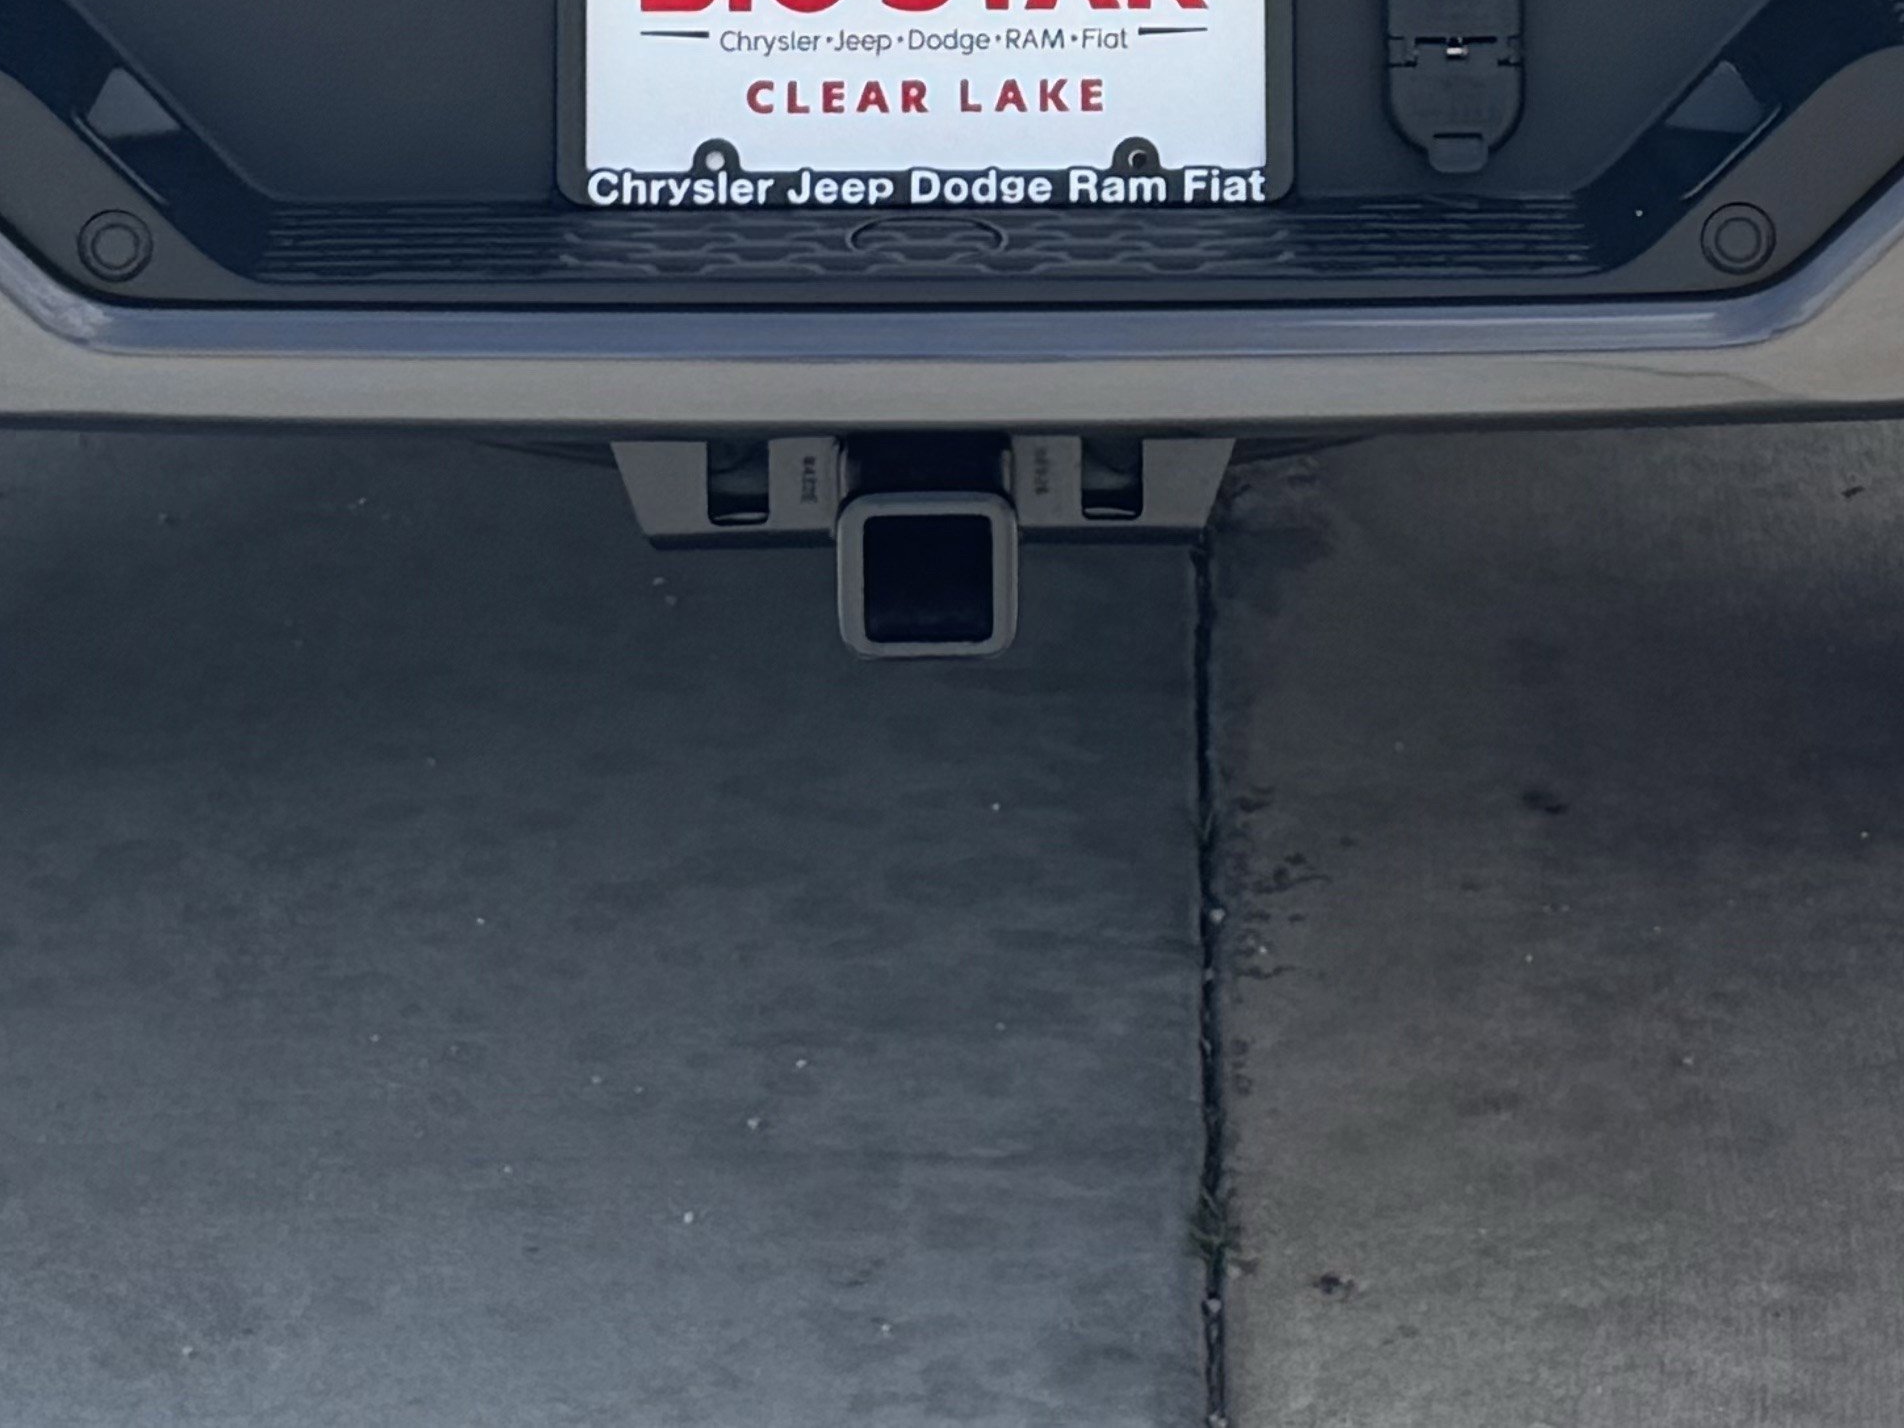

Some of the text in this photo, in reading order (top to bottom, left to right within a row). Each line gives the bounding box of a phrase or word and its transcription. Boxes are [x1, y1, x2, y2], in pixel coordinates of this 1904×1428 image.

[719, 27, 1129, 56] Chrysler Jeep Dodge RAM Fiat
[746, 78, 1105, 114] CLEAR LAKE
[586, 168, 1267, 207] Chrysler Jeep Dodge Ram Fiat
